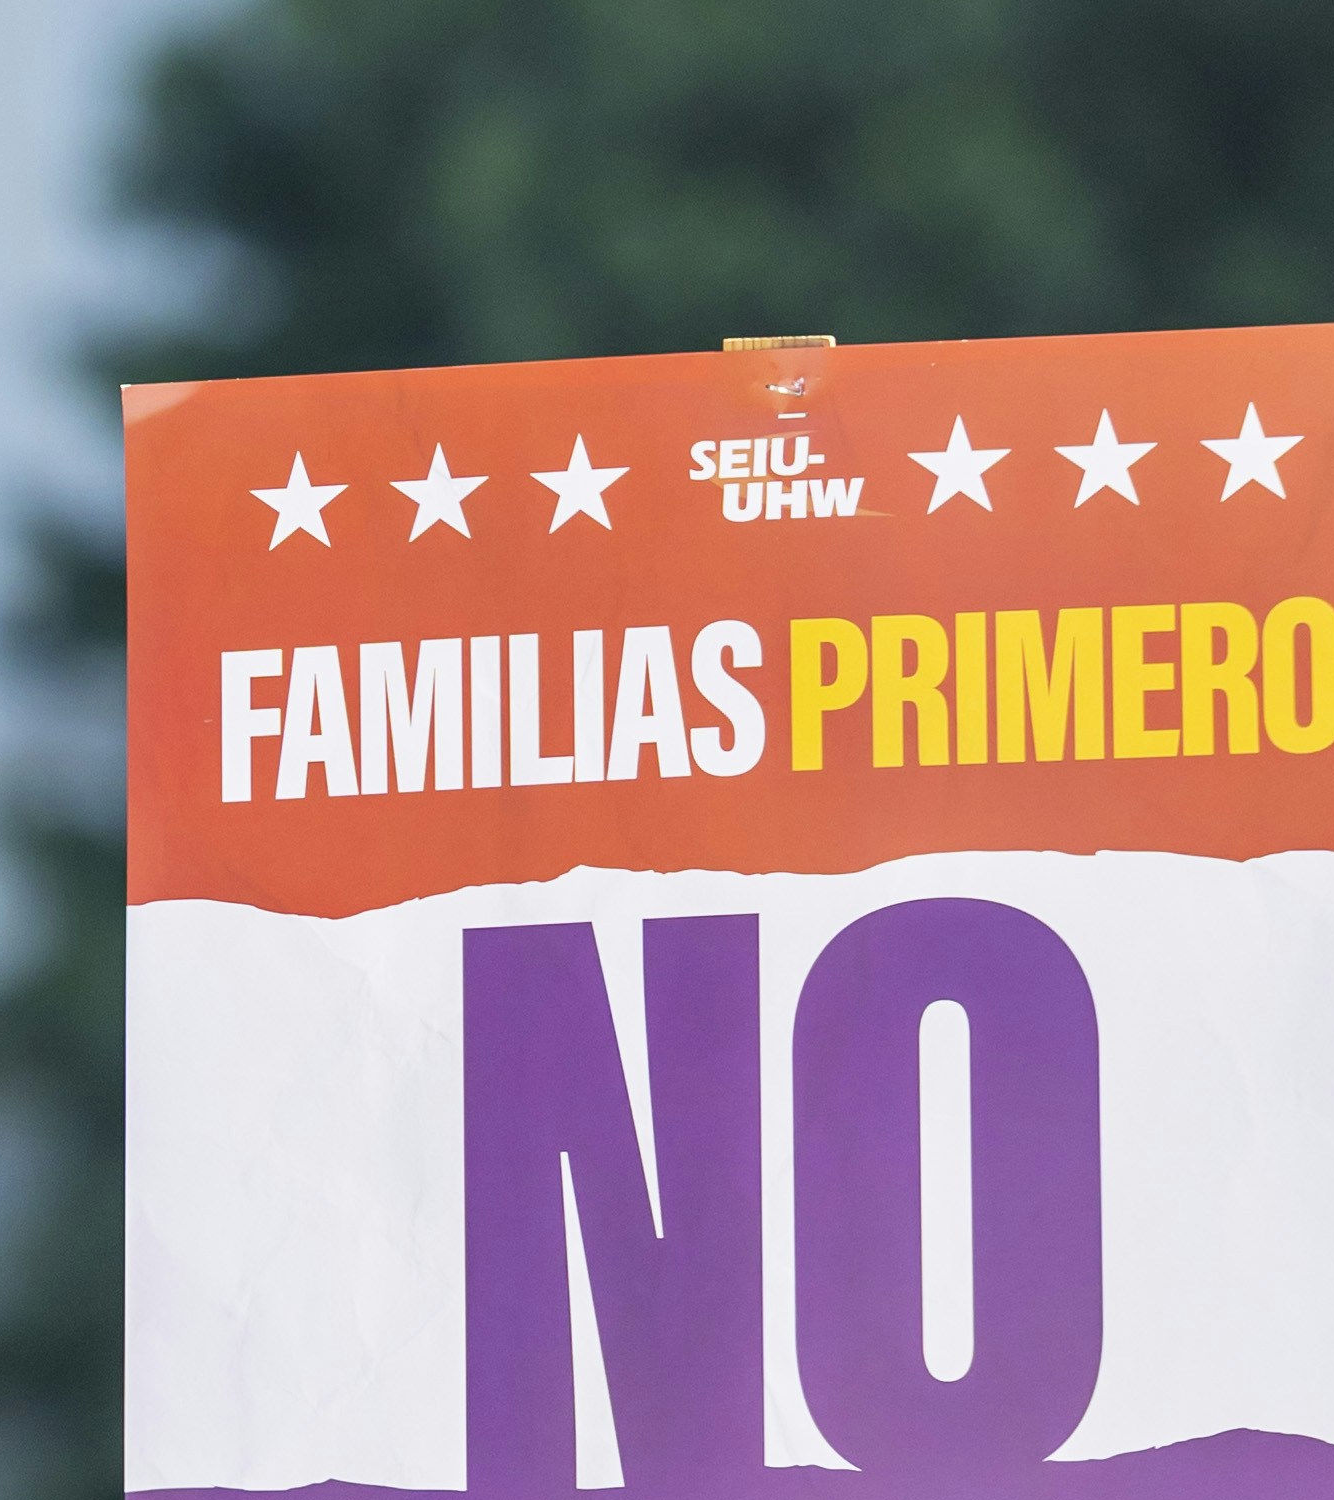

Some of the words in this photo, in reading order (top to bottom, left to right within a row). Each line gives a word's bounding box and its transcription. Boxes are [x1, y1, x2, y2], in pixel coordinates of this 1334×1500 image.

[688, 436, 825, 481] SEIU-
[722, 477, 865, 523] UHW
[220, 619, 766, 803] FAMILIAS
[462, 897, 1104, 1490] NO
